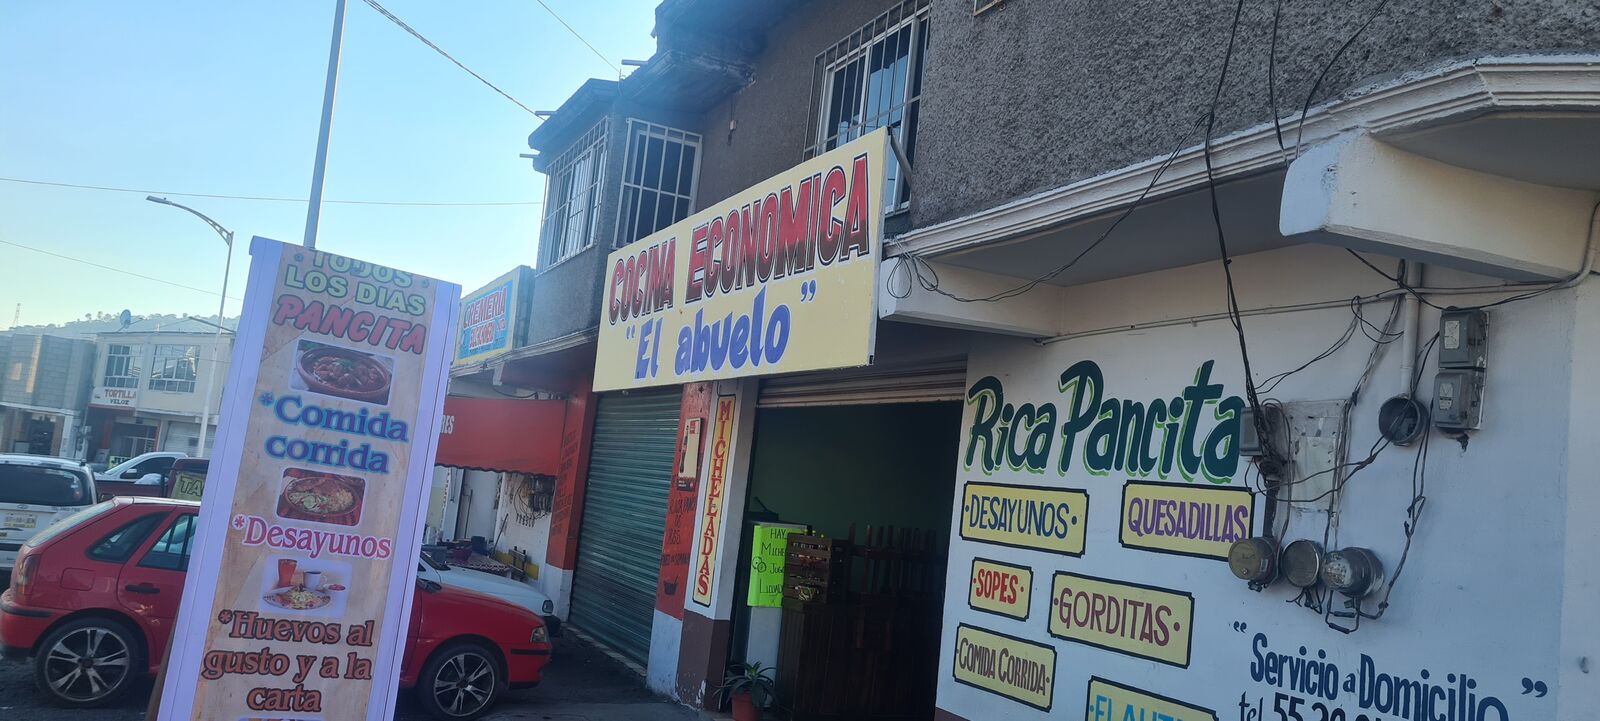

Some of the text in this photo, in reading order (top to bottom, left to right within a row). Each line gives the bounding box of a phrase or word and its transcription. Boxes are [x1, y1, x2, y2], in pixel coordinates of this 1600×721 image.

[608, 152, 871, 326] COCINA ECONOMICA
[285, 264, 426, 316] LOS DIAS
[272, 294, 427, 355] PANCITA
[963, 359, 1246, 485] Rica Pancita
[265, 435, 389, 474] corrida
[698, 400, 731, 596] MICHELADAS
[969, 494, 1069, 539] DESAYUNOS
[1128, 497, 1249, 544] QUESADILLAS
[770, 528, 787, 539] HAY
[976, 568, 1018, 605] SOPES
[346, 620, 375, 647] al
[1058, 587, 1172, 647] GORDITAS
[201, 646, 372, 683] gusto y a la
[959, 637, 1047, 696] COMIDA CORRIDA
[1342, 673, 1356, 693] a
[247, 684, 322, 712] carta
